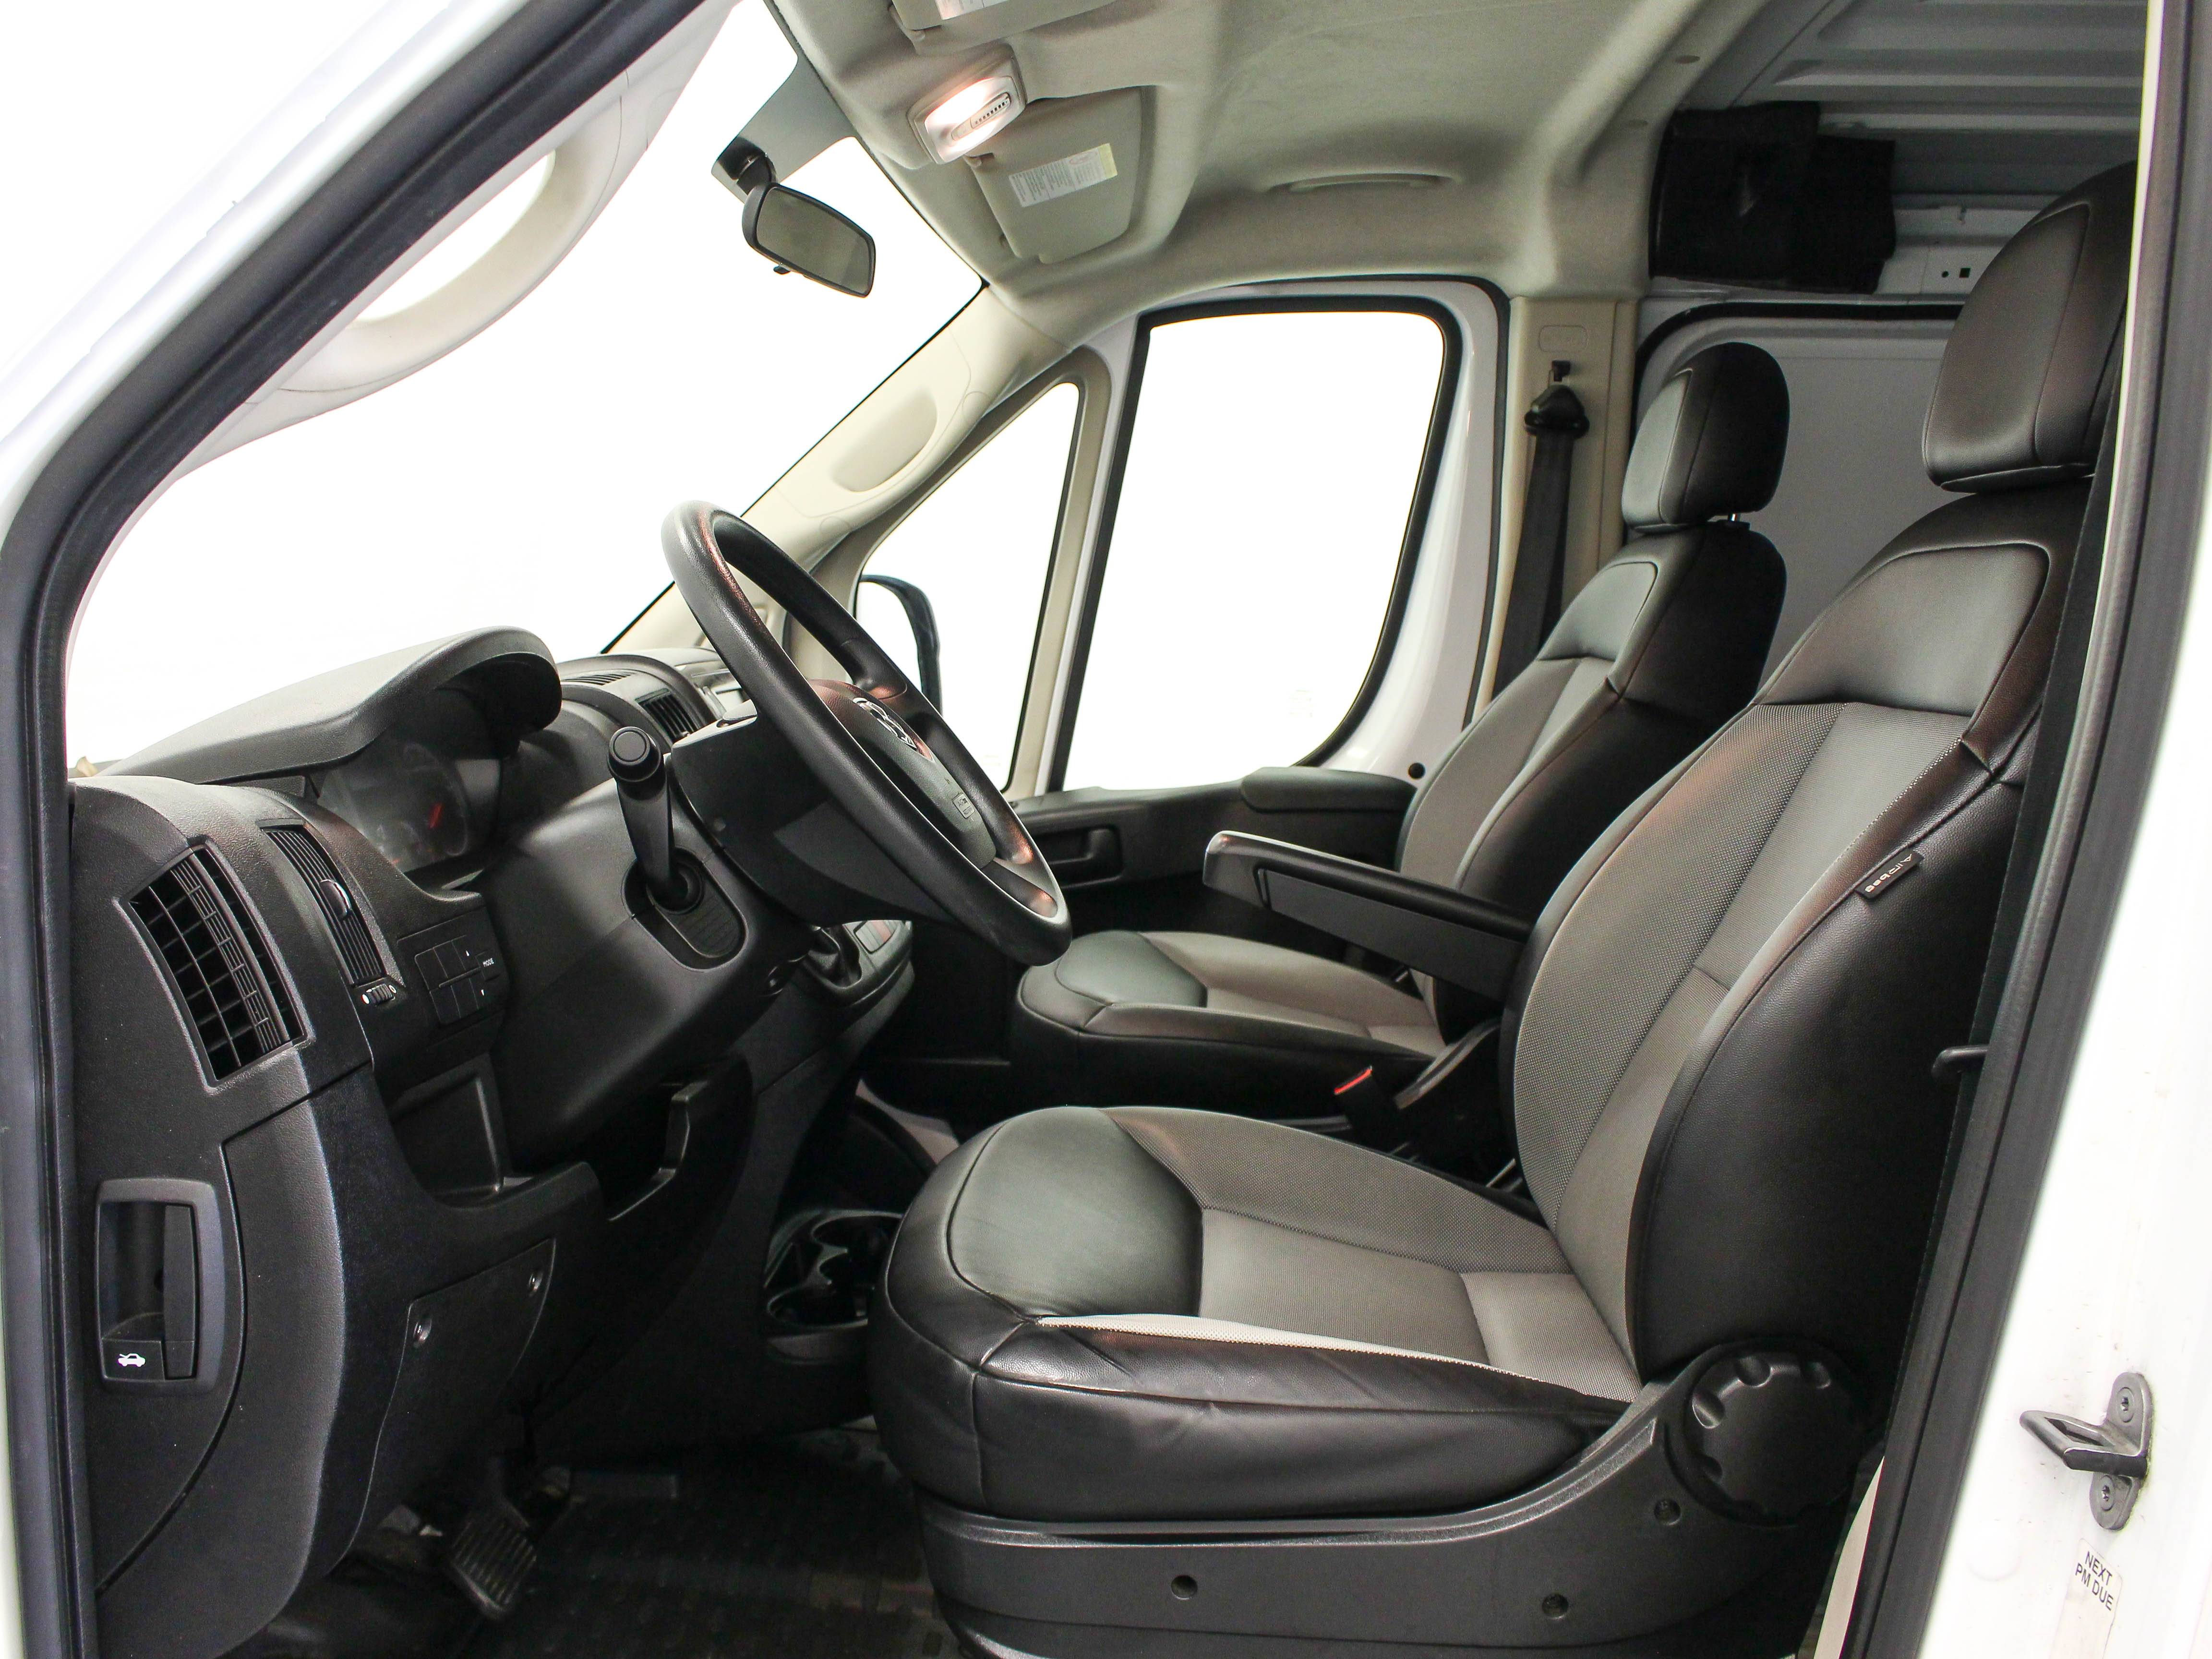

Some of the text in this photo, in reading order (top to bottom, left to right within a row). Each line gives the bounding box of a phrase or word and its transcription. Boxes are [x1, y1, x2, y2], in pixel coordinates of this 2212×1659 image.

[2075, 1562, 2114, 1611] PM DUE
[2085, 1551, 2113, 1586] NEXT
